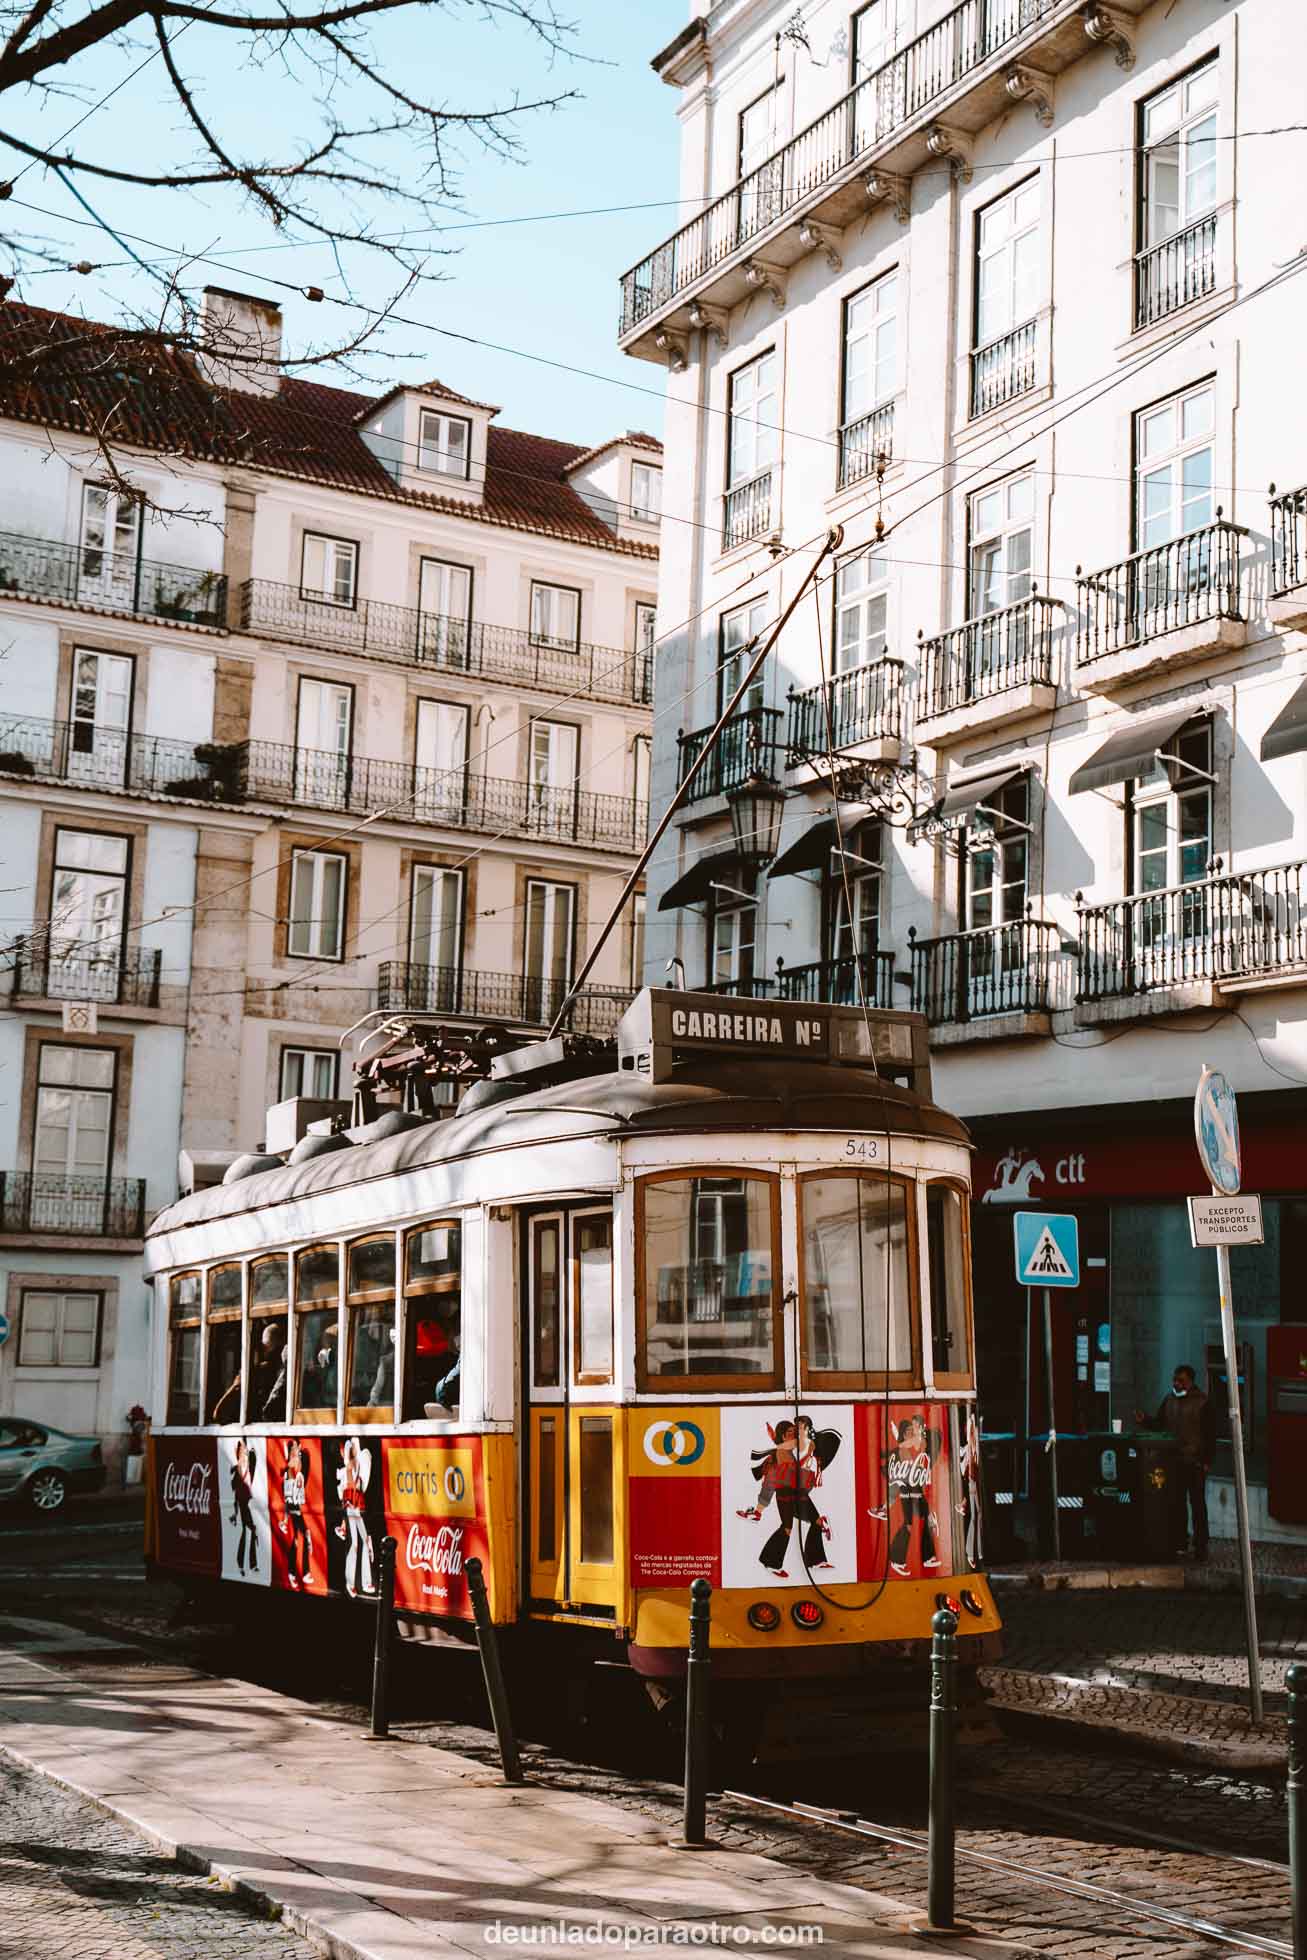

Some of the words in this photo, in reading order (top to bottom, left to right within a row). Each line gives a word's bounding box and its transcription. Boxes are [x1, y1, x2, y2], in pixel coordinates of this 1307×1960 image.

[672, 1010, 783, 1043] CARREIRA
[795, 1020, 821, 1046] Nº
[846, 1139, 877, 1158] 543
[1055, 1153, 1085, 1184] ctt
[1199, 1215, 1257, 1225] TRANSPORTES
[1208, 1207, 1244, 1216] EXCEPTO
[163, 1462, 212, 1514] Coca-Cola
[396, 1463, 437, 1496] carris
[406, 1523, 464, 1576] Coca-Cola
